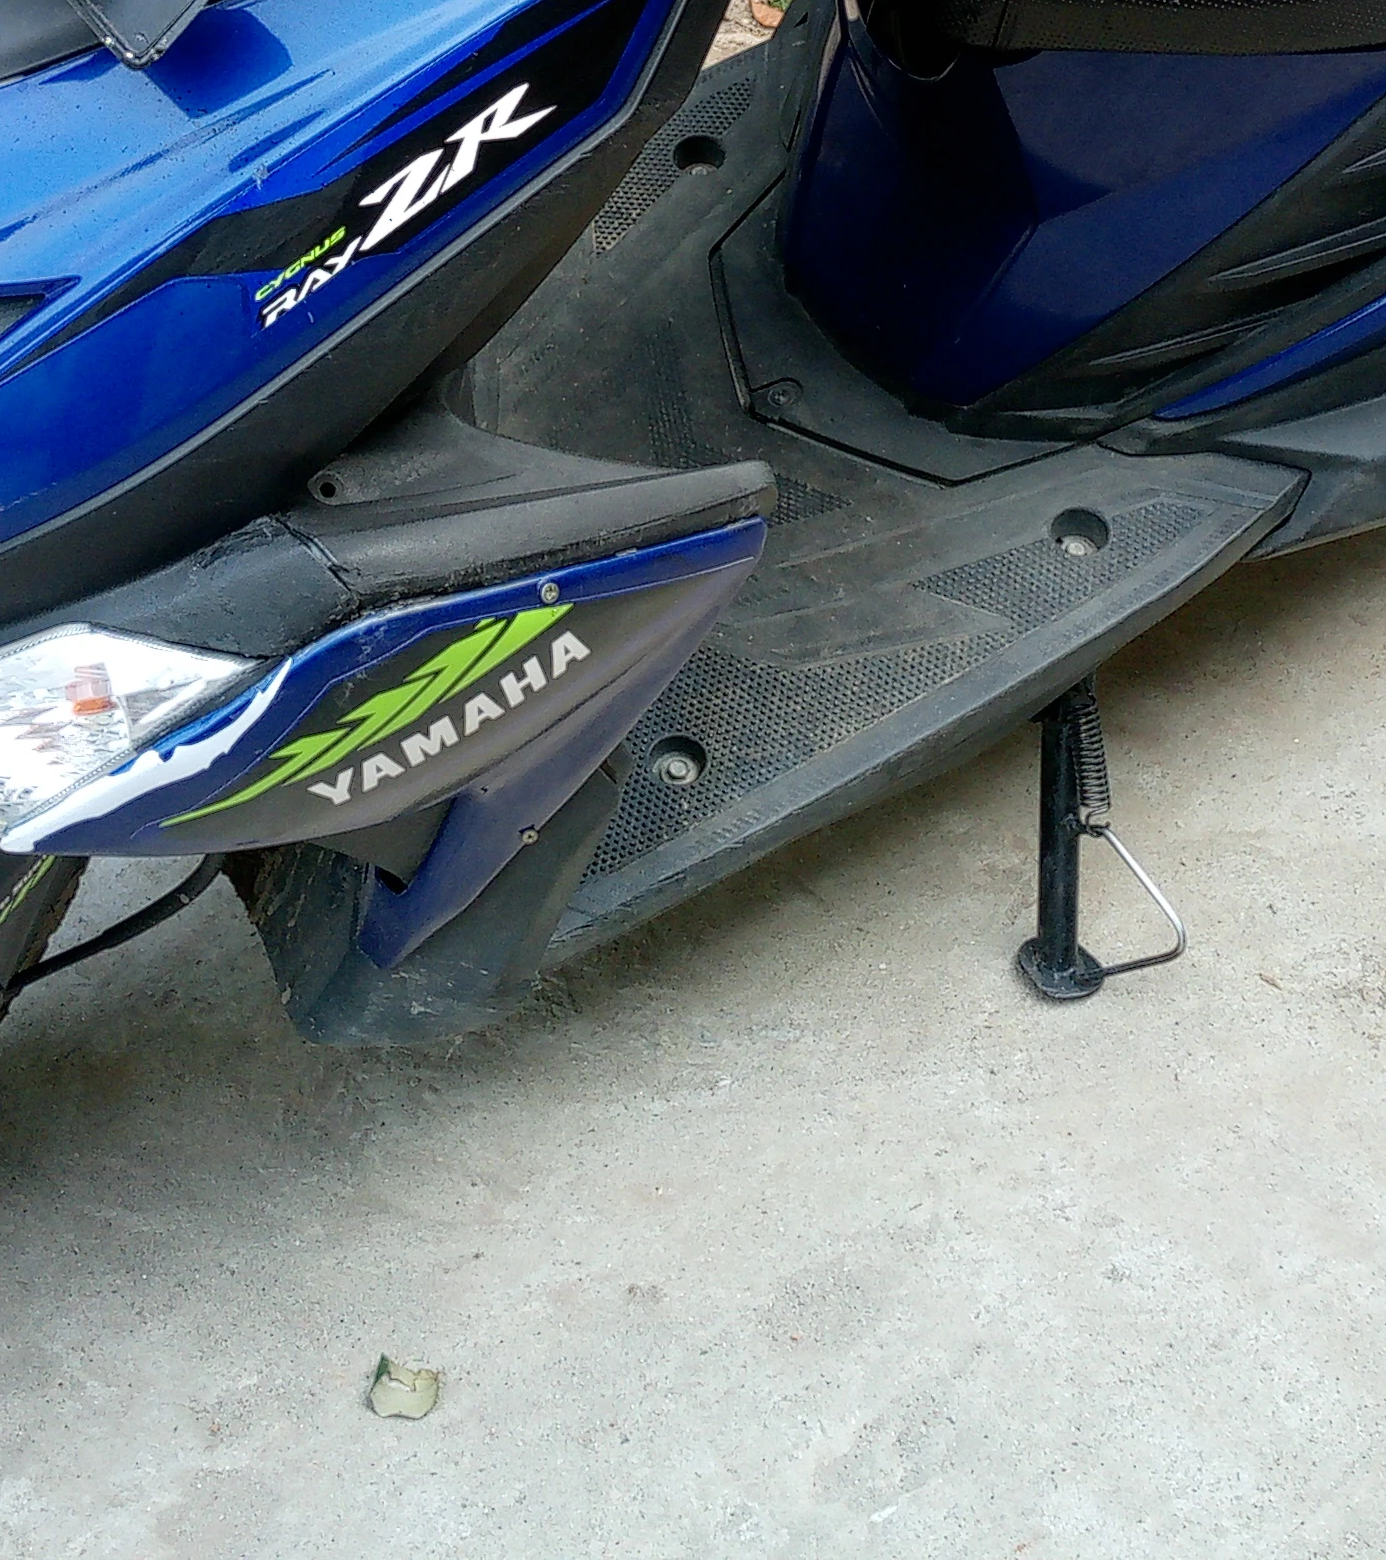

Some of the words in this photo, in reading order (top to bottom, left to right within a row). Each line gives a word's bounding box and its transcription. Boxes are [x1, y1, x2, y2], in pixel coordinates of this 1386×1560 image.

[359, 82, 557, 251] ZR
[255, 226, 346, 301] CYGNUS
[308, 630, 592, 806] YAMAHA
